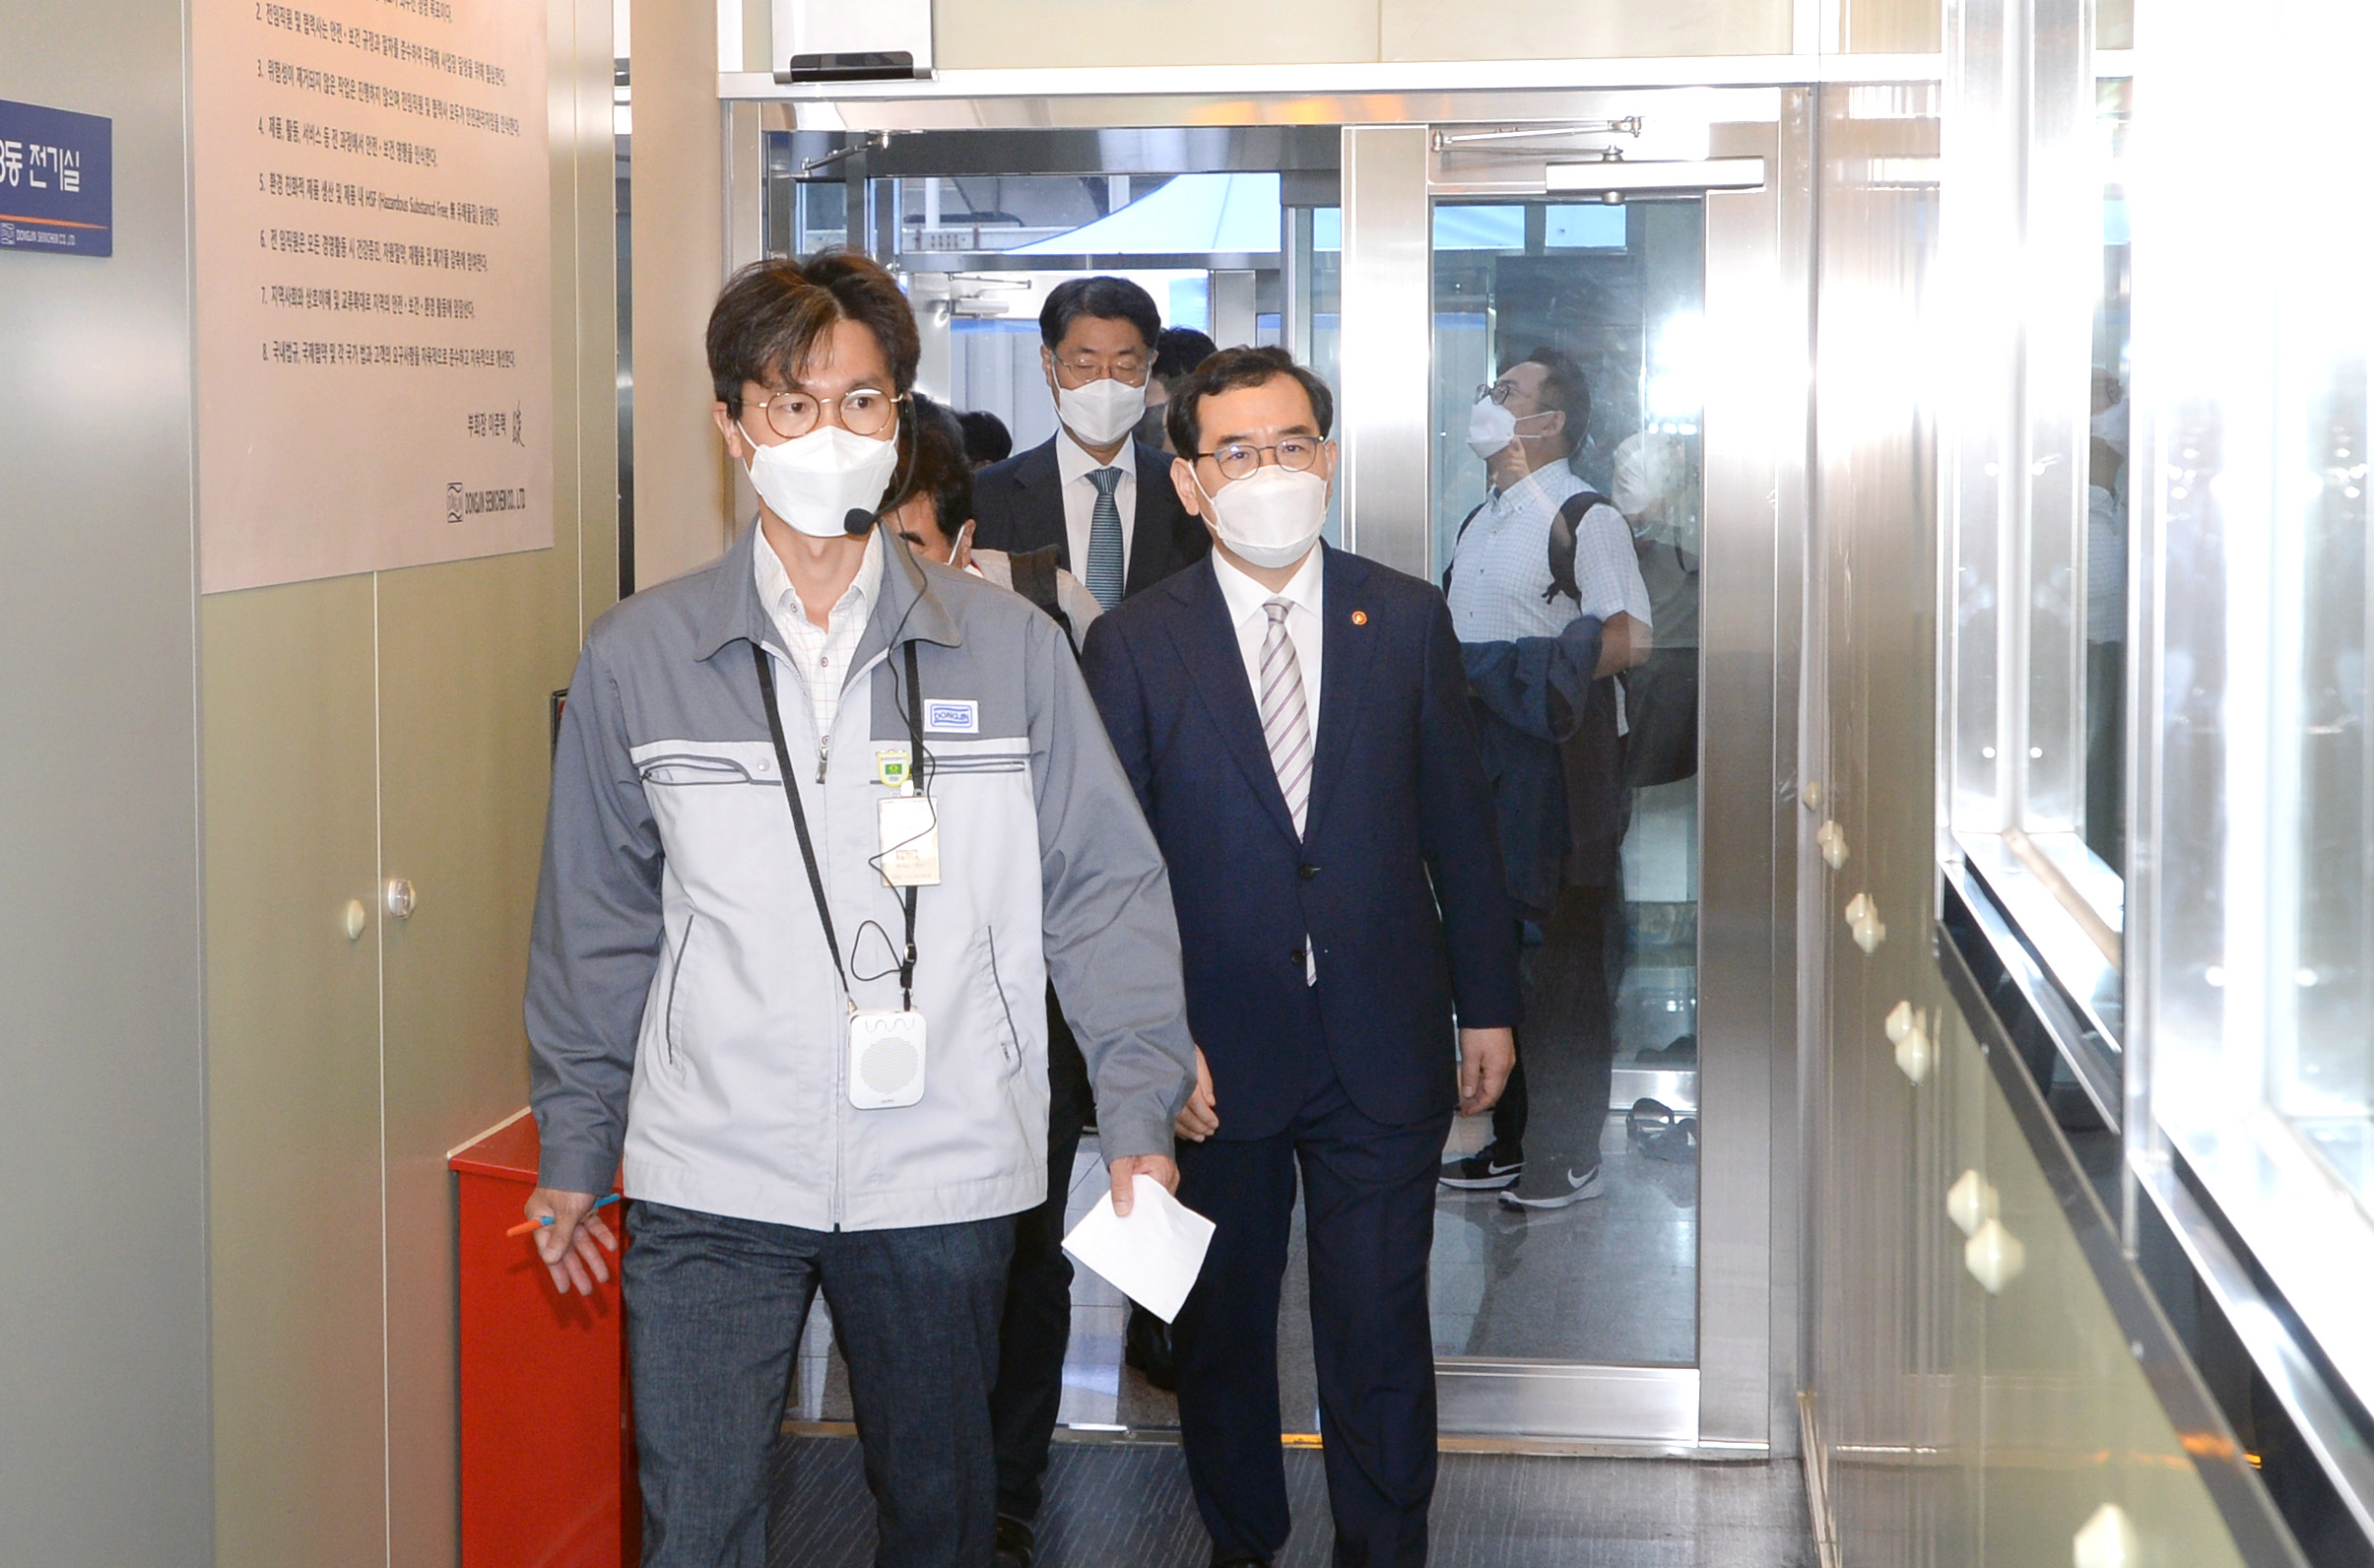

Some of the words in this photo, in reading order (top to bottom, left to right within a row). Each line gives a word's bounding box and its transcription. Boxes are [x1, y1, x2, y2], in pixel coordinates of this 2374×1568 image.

[329, 21, 342, 43] 안전
[348, 28, 360, 48] 보건
[267, 59, 294, 87] 위험성이
[296, 67, 321, 93] 제거되지
[323, 73, 336, 96] 않은
[337, 76, 357, 99] 작업은
[301, 123, 321, 146] 서비스
[323, 127, 330, 149] 등
[365, 136, 377, 157] 안전
[383, 140, 395, 160] 보건
[30, 144, 80, 192] 전기실
[269, 172, 284, 195] 환경
[285, 175, 303, 199] 친화적
[305, 178, 319, 201] 제품
[321, 180, 334, 203] 생산
[335, 183, 343, 204] 및
[343, 184, 357, 206] 제품
[279, 229, 305, 253] 임직원은
[306, 233, 320, 255] 모든
[321, 235, 347, 258] 경영활동
[271, 285, 303, 308] 지역사회와
[305, 288, 331, 310] 상호이해
[333, 290, 340, 311] 및
[391, 294, 402, 314] 안전
